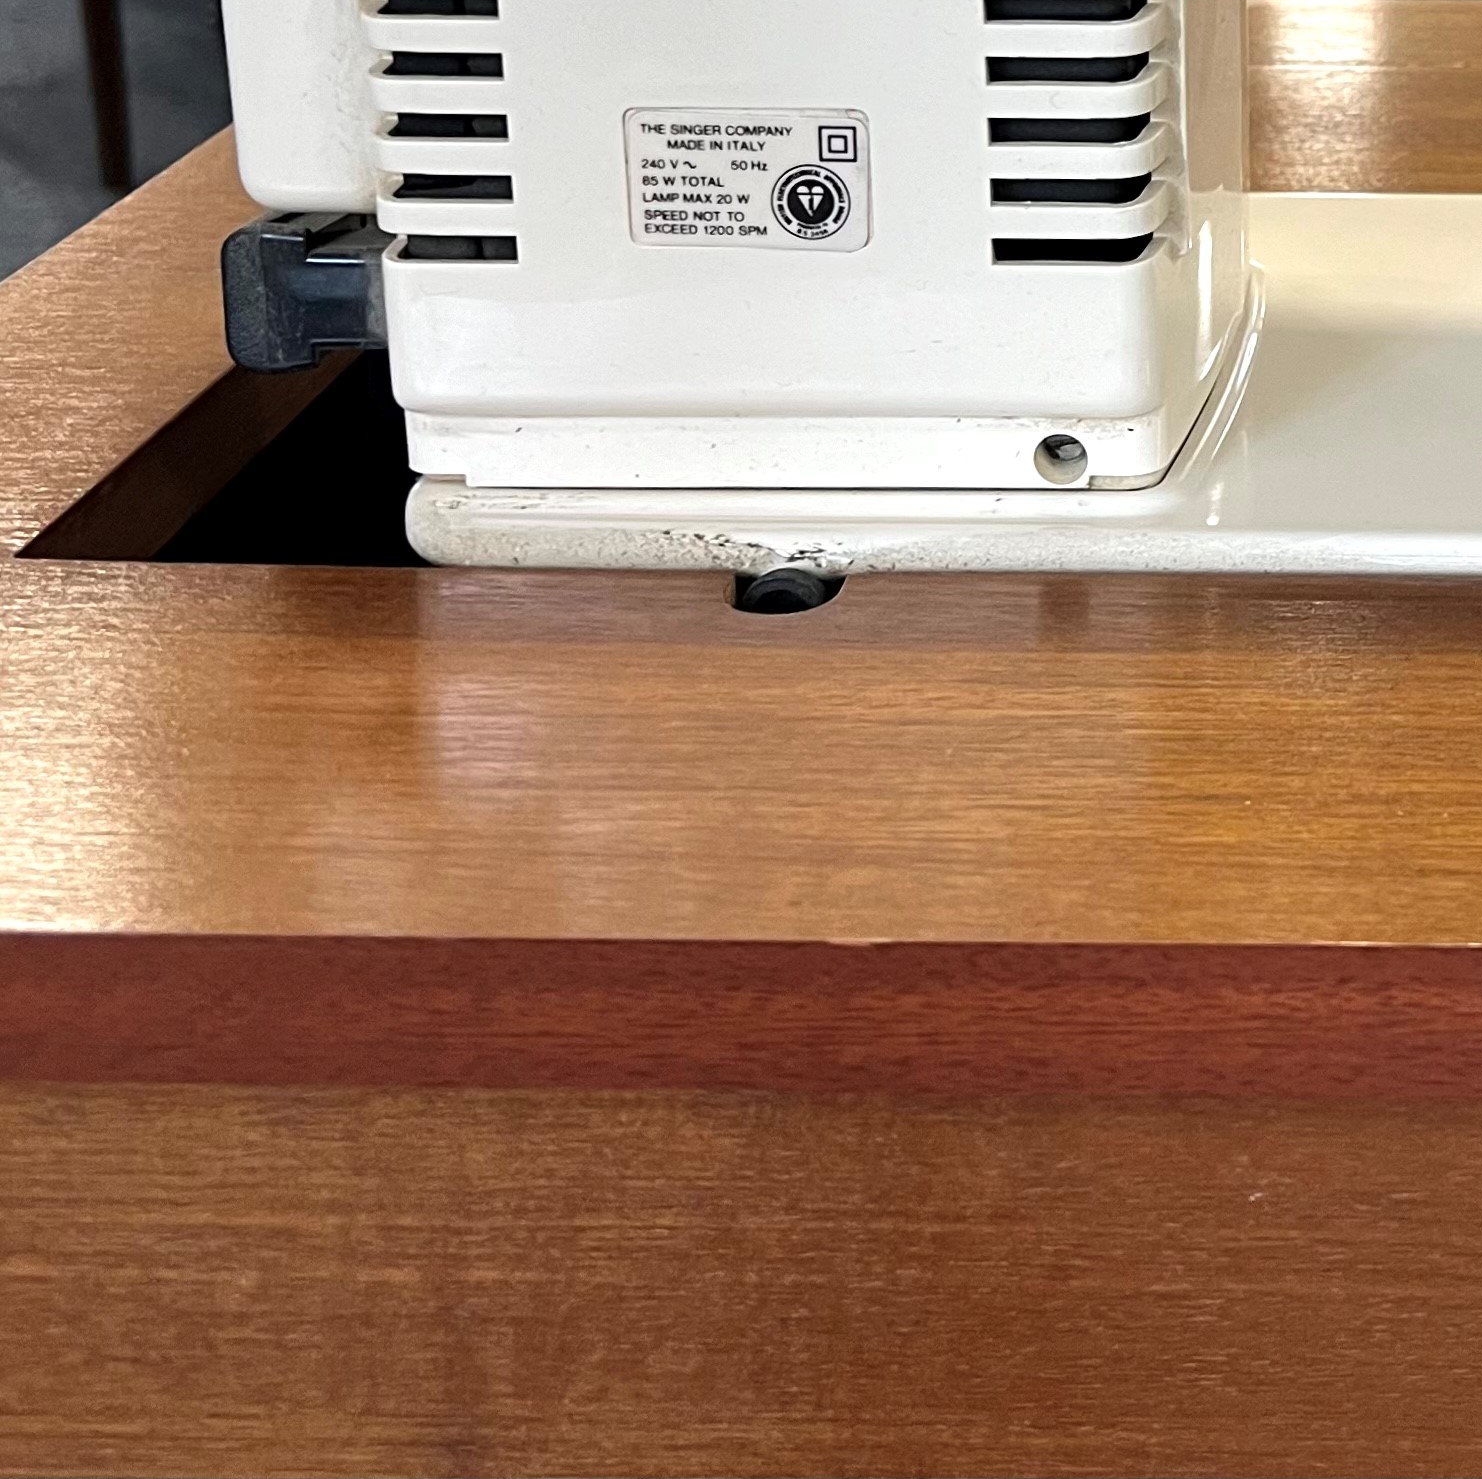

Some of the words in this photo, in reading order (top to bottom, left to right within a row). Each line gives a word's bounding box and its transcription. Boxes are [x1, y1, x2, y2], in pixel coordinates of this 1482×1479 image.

[640, 123, 666, 135] THE
[670, 124, 722, 136] SINGER
[724, 125, 793, 137] COMPANY
[667, 139, 705, 151] MADE
[709, 140, 724, 151] IN
[727, 140, 766, 152] ITALY
[641, 158, 666, 170] 240
[670, 159, 679, 170] V
[730, 160, 748, 171] 50
[750, 160, 769, 172] Hz
[642, 175, 659, 187] 85
[662, 176, 676, 187] W
[681, 176, 725, 188] TOTAL
[642, 192, 680, 204] LAMP
[682, 193, 713, 205] MAX
[716, 194, 733, 205] 20
[736, 194, 751, 205] W
[644, 210, 689, 222] SPEED
[692, 211, 721, 223] NOT
[727, 211, 745, 223] TO
[644, 223, 699, 235] EXCEED
[703, 225, 735, 236] 1200
[737, 226, 769, 237] SPM
